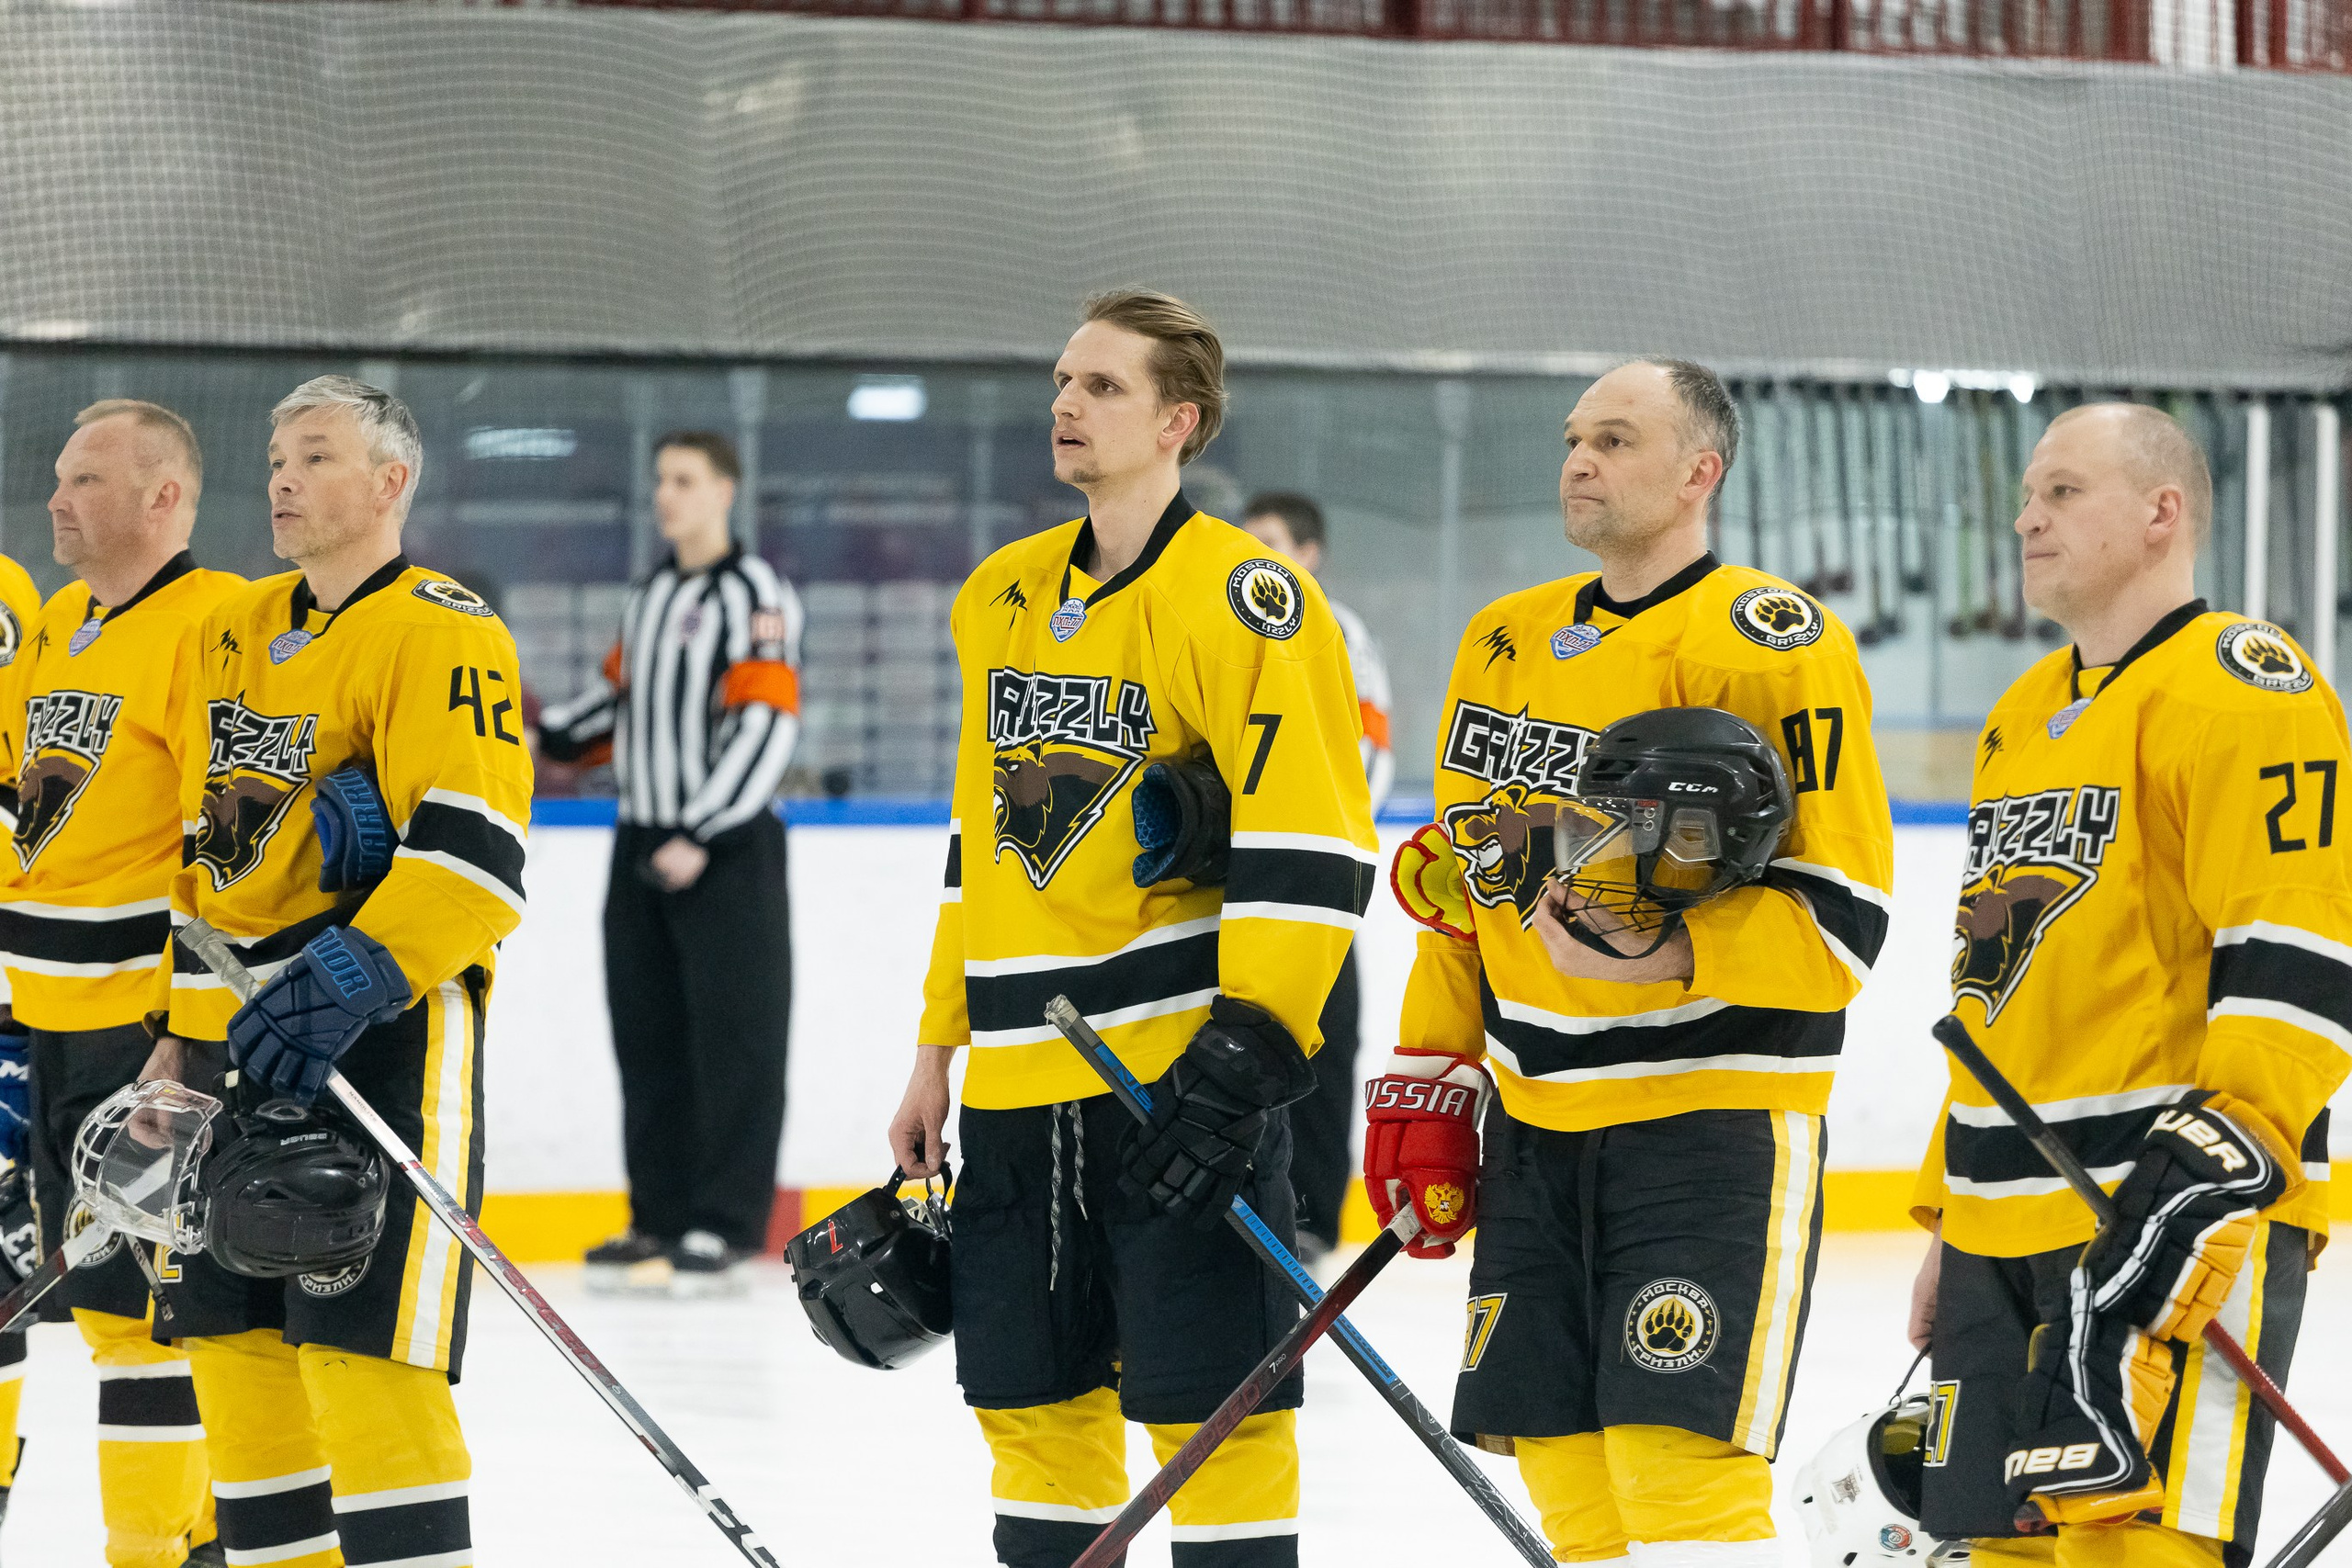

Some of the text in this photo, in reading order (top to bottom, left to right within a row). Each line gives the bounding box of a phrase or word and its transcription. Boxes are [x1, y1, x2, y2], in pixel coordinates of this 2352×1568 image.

[1232, 560, 1289, 588] MOSCOW
[1766, 622, 1819, 646] GRIZZLY
[448, 665, 520, 746] 42
[1241, 713, 1283, 795] 7
[1440, 698, 1601, 797] GRIZZ
[1780, 706, 1844, 795] 87
[1667, 781, 1719, 794] CCM
[2258, 760, 2338, 855] 27
[1641, 1283, 1709, 1309] МОСКВА
[1632, 1344, 1700, 1368] ГРИЗЛИ
